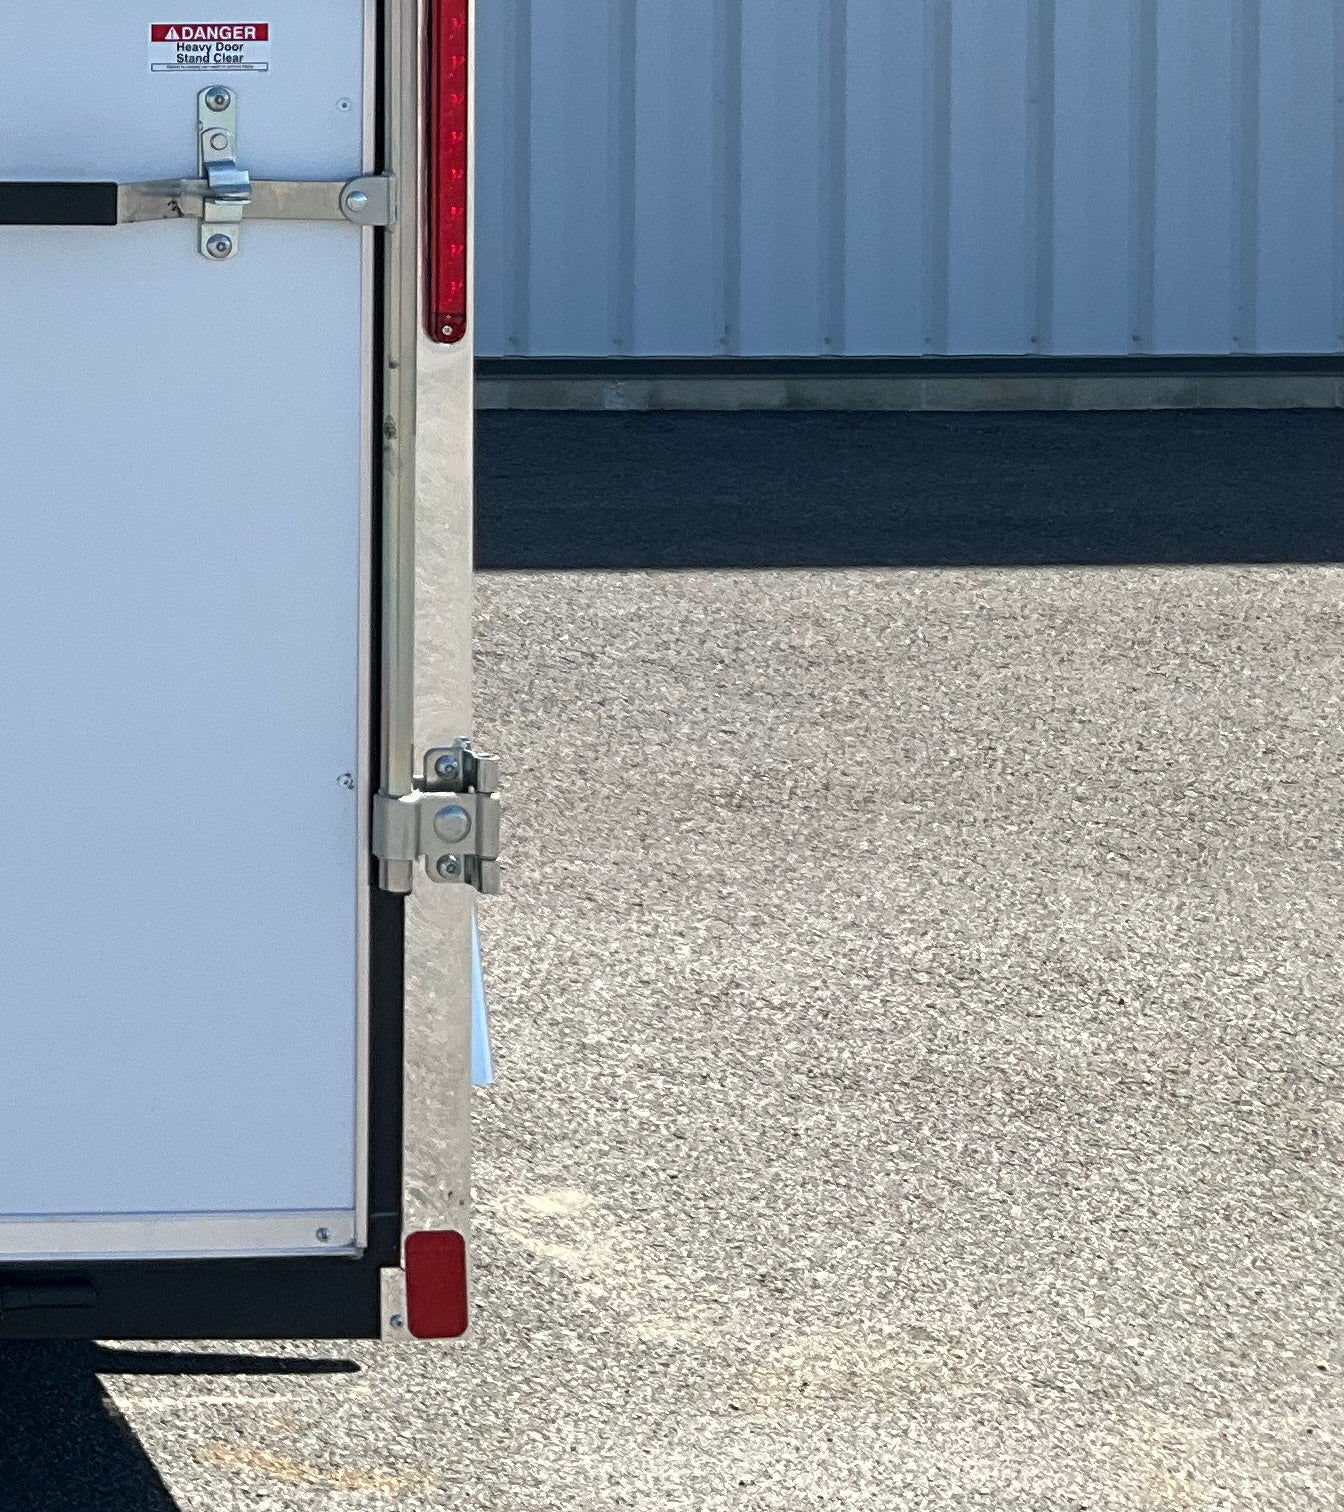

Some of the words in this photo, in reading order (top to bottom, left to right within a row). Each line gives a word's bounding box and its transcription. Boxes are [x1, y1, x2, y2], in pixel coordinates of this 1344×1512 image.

[182, 25, 256, 40] DANGER
[176, 42, 212, 55] Heavy
[215, 42, 244, 52] Door
[176, 53, 210, 63] Stand
[213, 53, 244, 63] Clear
